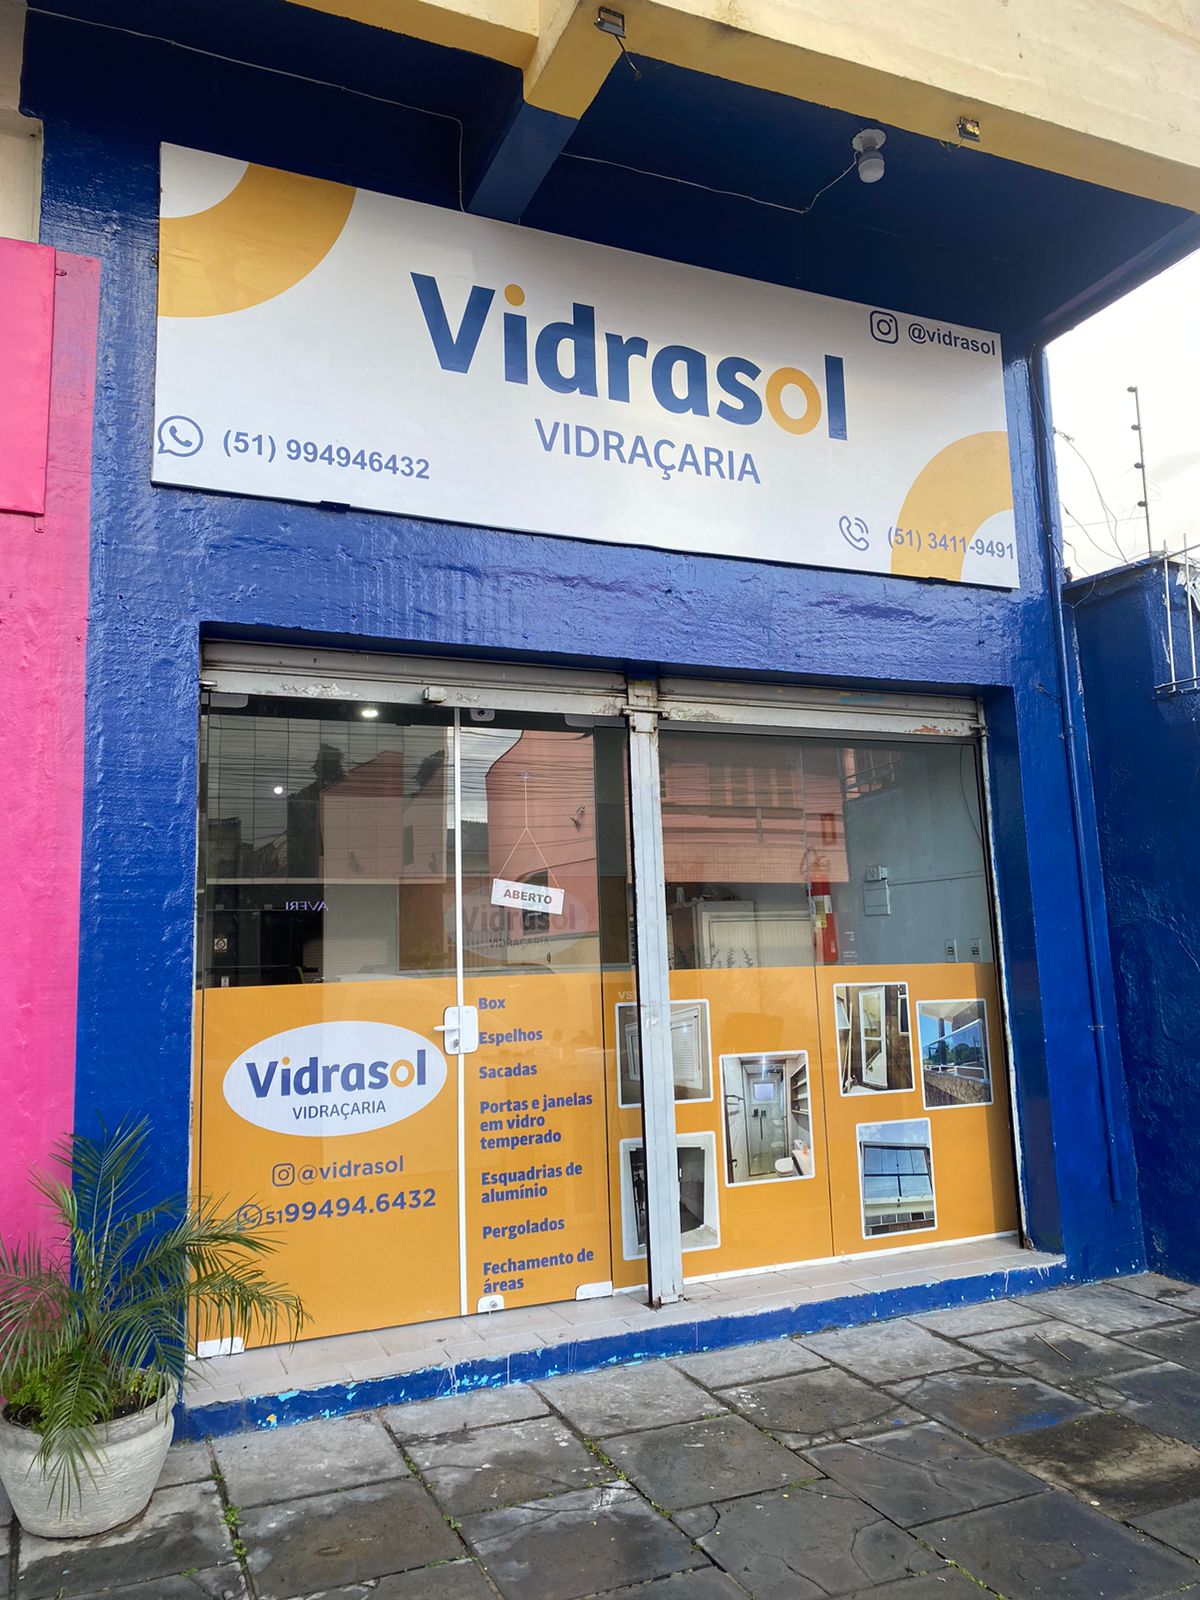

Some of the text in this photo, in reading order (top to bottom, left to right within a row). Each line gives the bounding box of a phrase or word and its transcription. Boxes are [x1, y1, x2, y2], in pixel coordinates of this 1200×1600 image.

[908, 322, 996, 356] @vidrasol
[410, 272, 848, 441] Vidrasol
[222, 429, 431, 480] (51) 994946432
[534, 417, 761, 485] VIDRAÇARIA
[887, 526, 1014, 560] (51) 3411-9491
[503, 888, 553, 905] ABERTO
[478, 997, 506, 1010] Box
[478, 1028, 543, 1046] Espelhos
[245, 1048, 426, 1098] Vidrasol
[479, 1062, 538, 1079] Sacadas
[292, 1100, 386, 1120] VIDRAÇARIA
[480, 1092, 593, 1114] Portas e janelas
[480, 1113, 545, 1132] em vidro
[480, 1129, 562, 1150] temperado
[297, 1155, 404, 1185] @vidrasol
[481, 1161, 583, 1186] Esquadrias de
[481, 1182, 548, 1204] alumínio
[482, 1217, 565, 1240] Pergolados
[483, 1247, 594, 1276] Fechamento de
[483, 1278, 524, 1294] áreas
